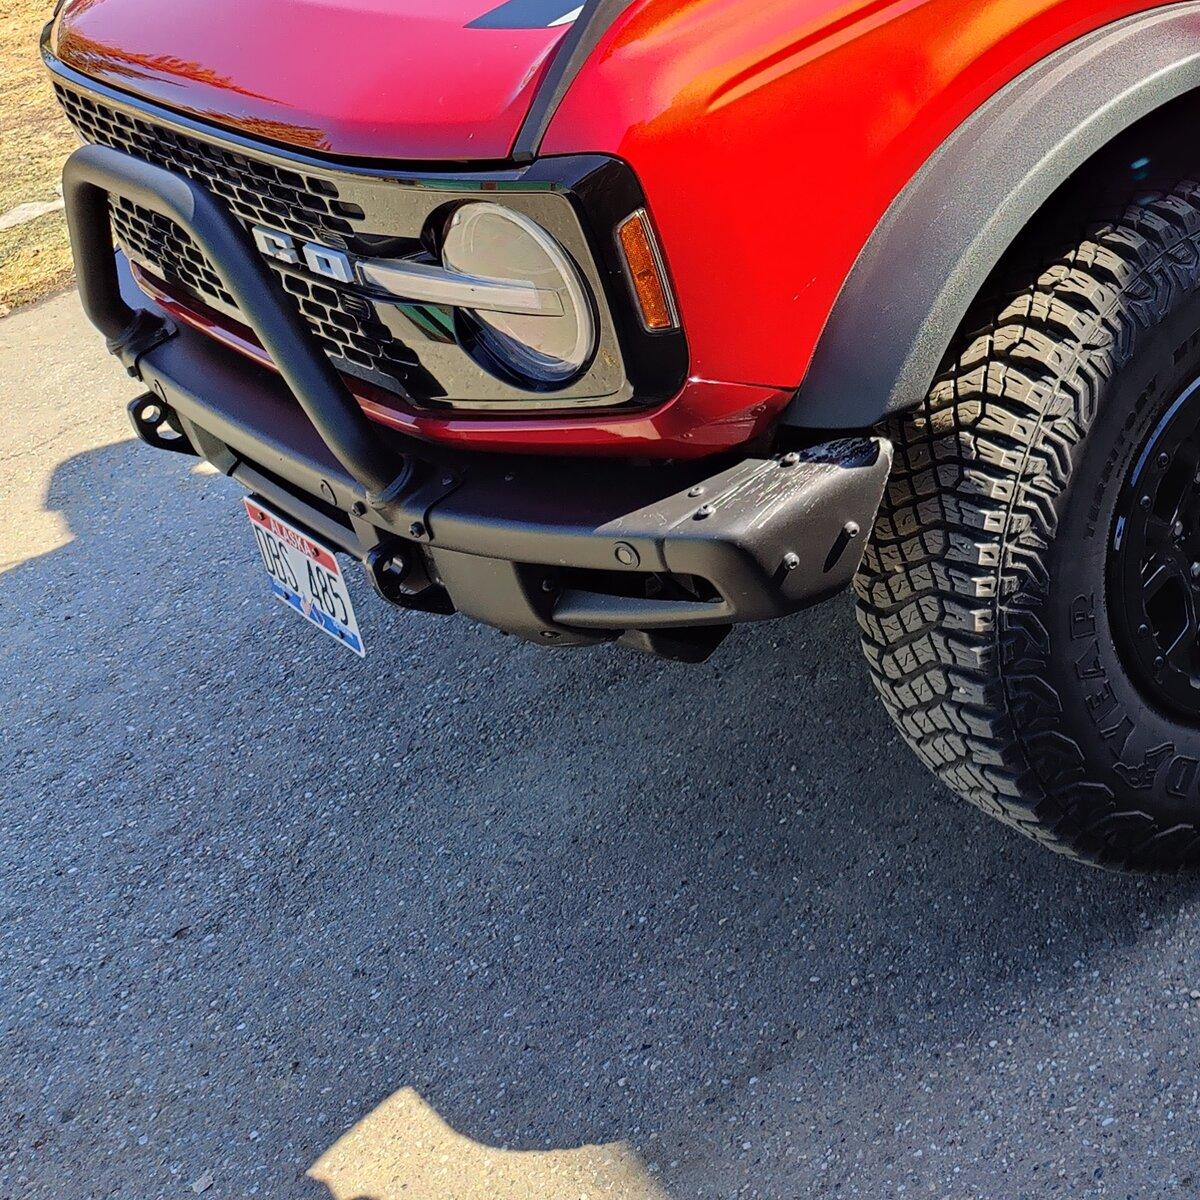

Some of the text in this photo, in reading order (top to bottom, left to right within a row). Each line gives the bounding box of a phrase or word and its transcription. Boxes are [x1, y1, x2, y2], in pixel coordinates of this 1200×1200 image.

[269, 519, 313, 556] ALASKA
[254, 526, 349, 626] DBS 485
